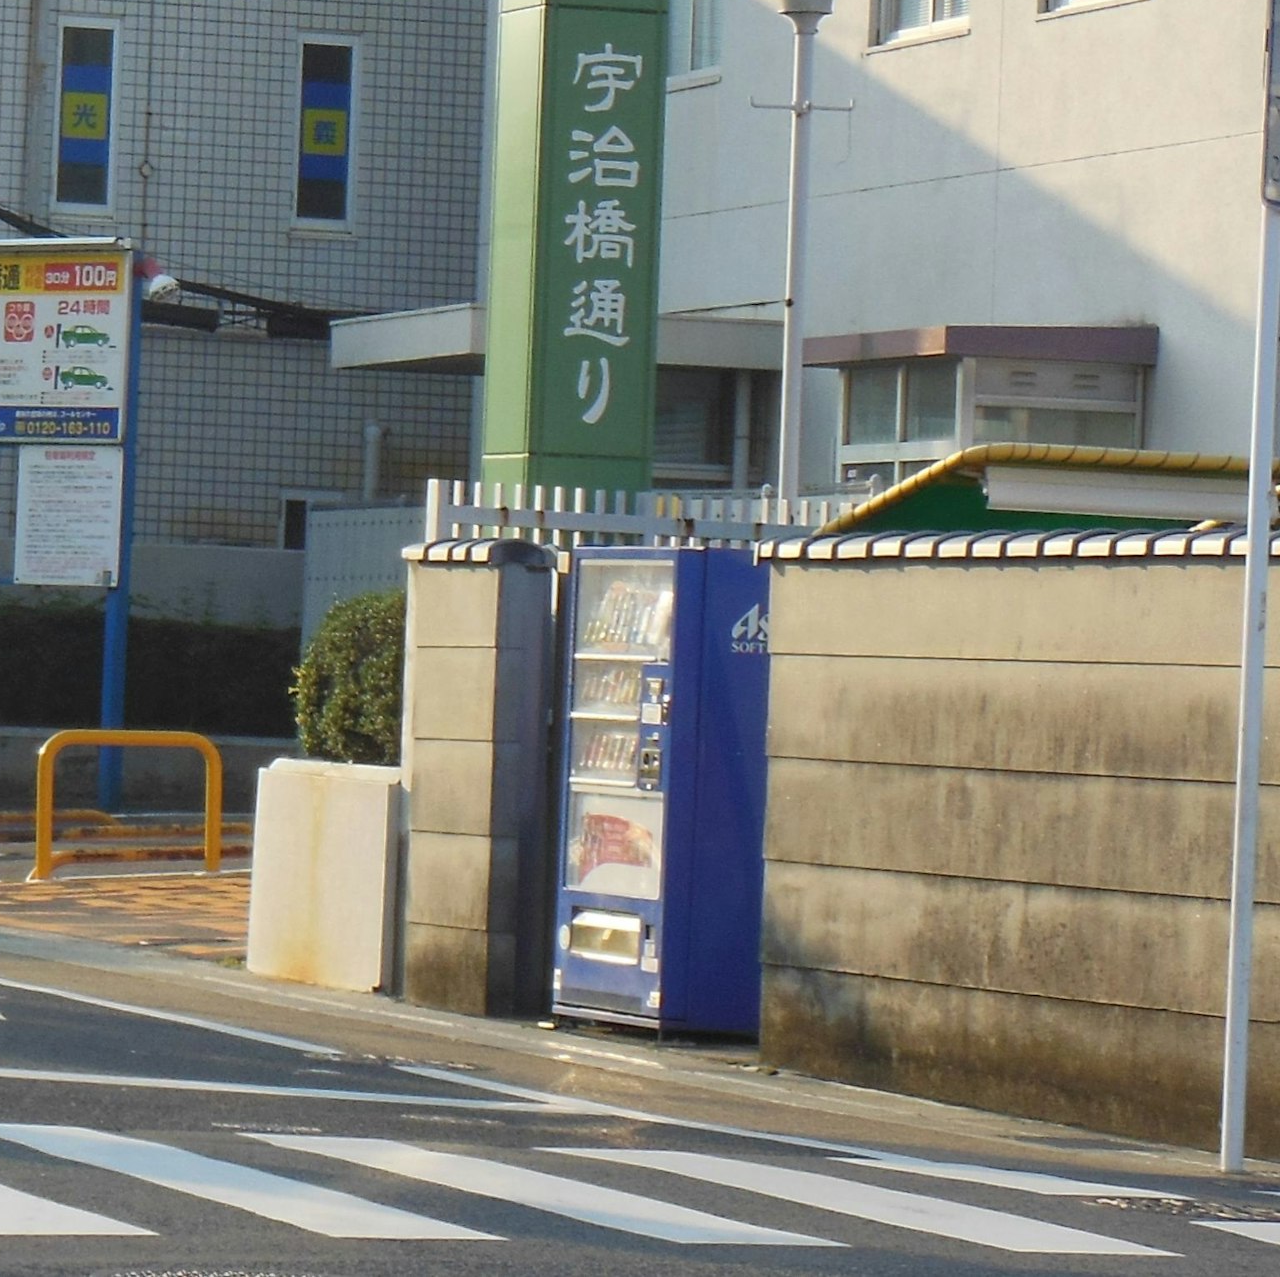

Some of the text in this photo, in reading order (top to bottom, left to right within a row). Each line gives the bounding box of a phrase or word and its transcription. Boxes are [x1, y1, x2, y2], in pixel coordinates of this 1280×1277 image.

[72, 103, 97, 129] 光
[563, 42, 643, 425] 宇治橋通り
[75, 265, 117, 286] 100円
